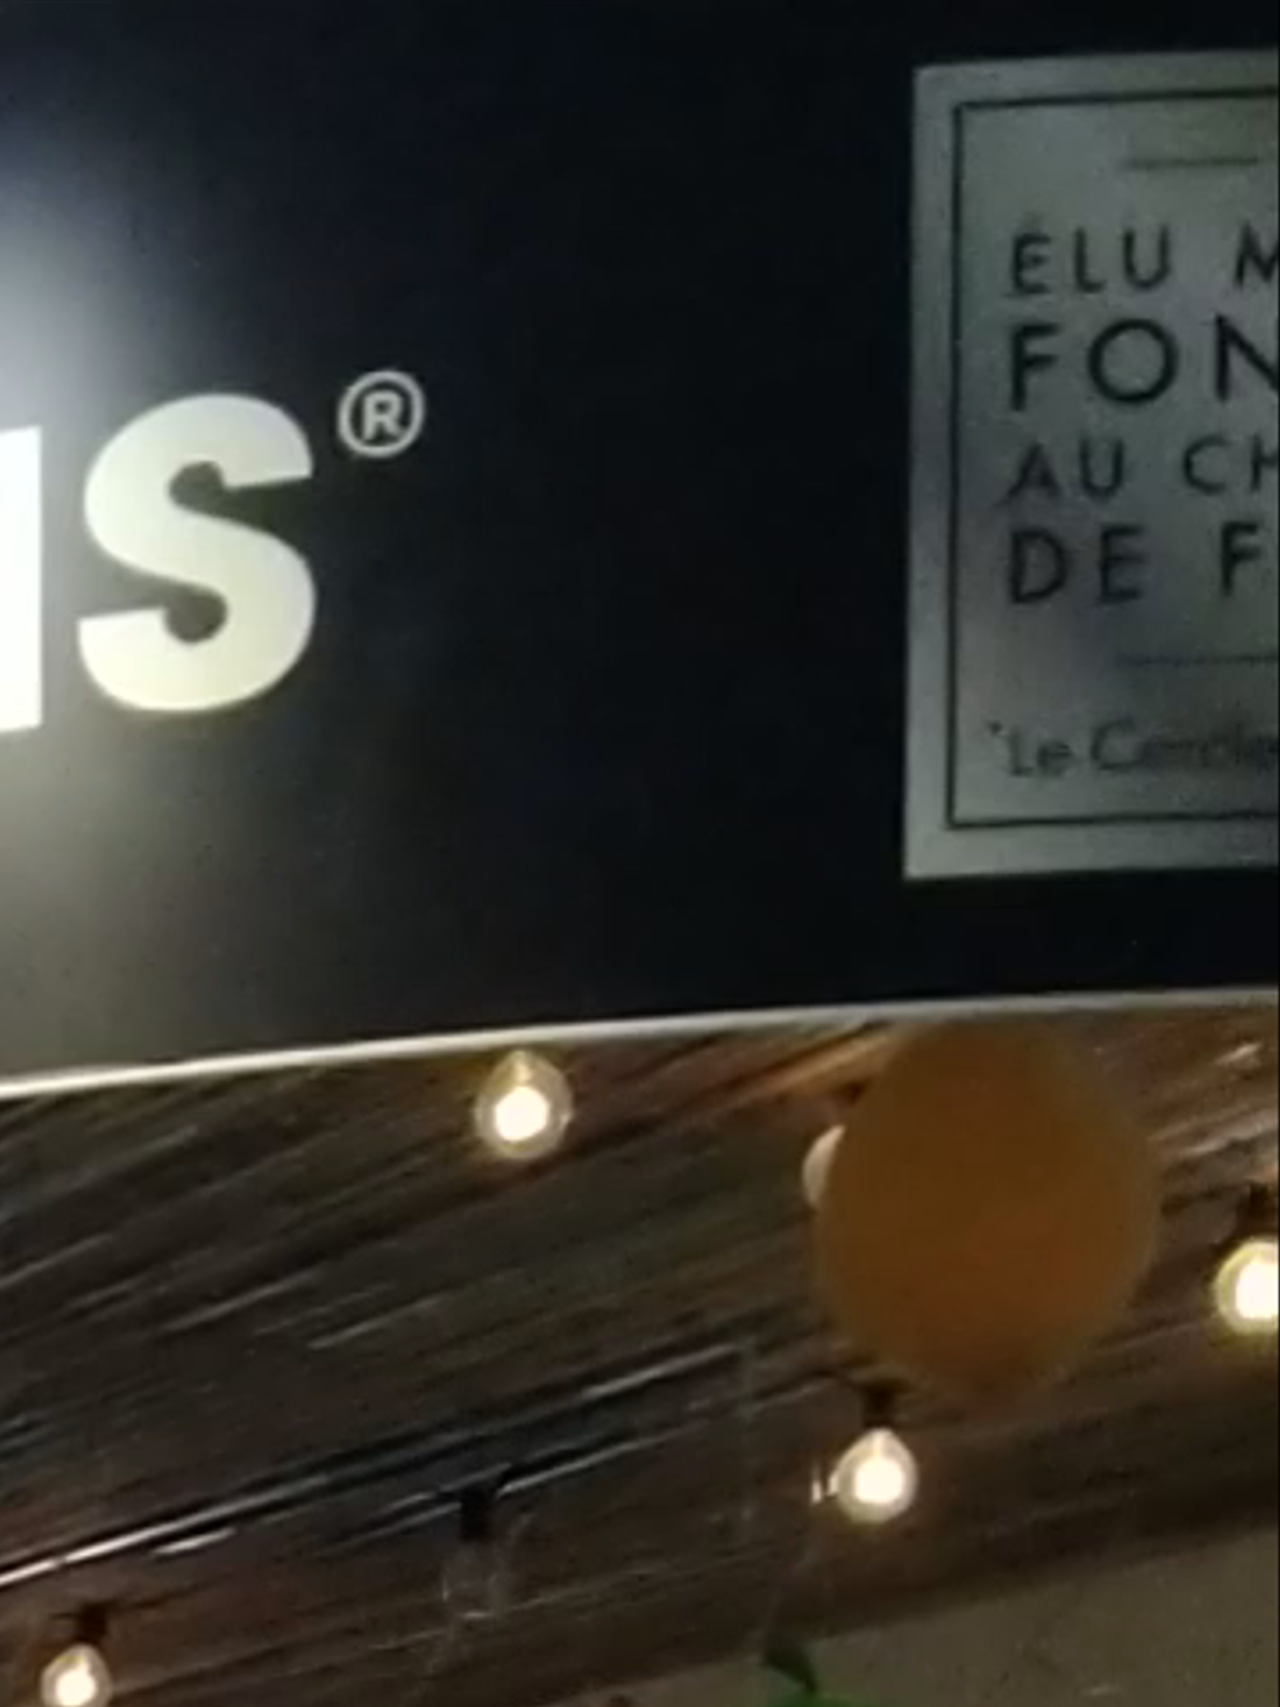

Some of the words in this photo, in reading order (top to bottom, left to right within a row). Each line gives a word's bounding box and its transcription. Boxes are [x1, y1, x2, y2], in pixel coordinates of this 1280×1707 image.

[1007, 437, 1124, 498] AU
[1008, 523, 1147, 604] DE
[1220, 521, 1261, 598] F
